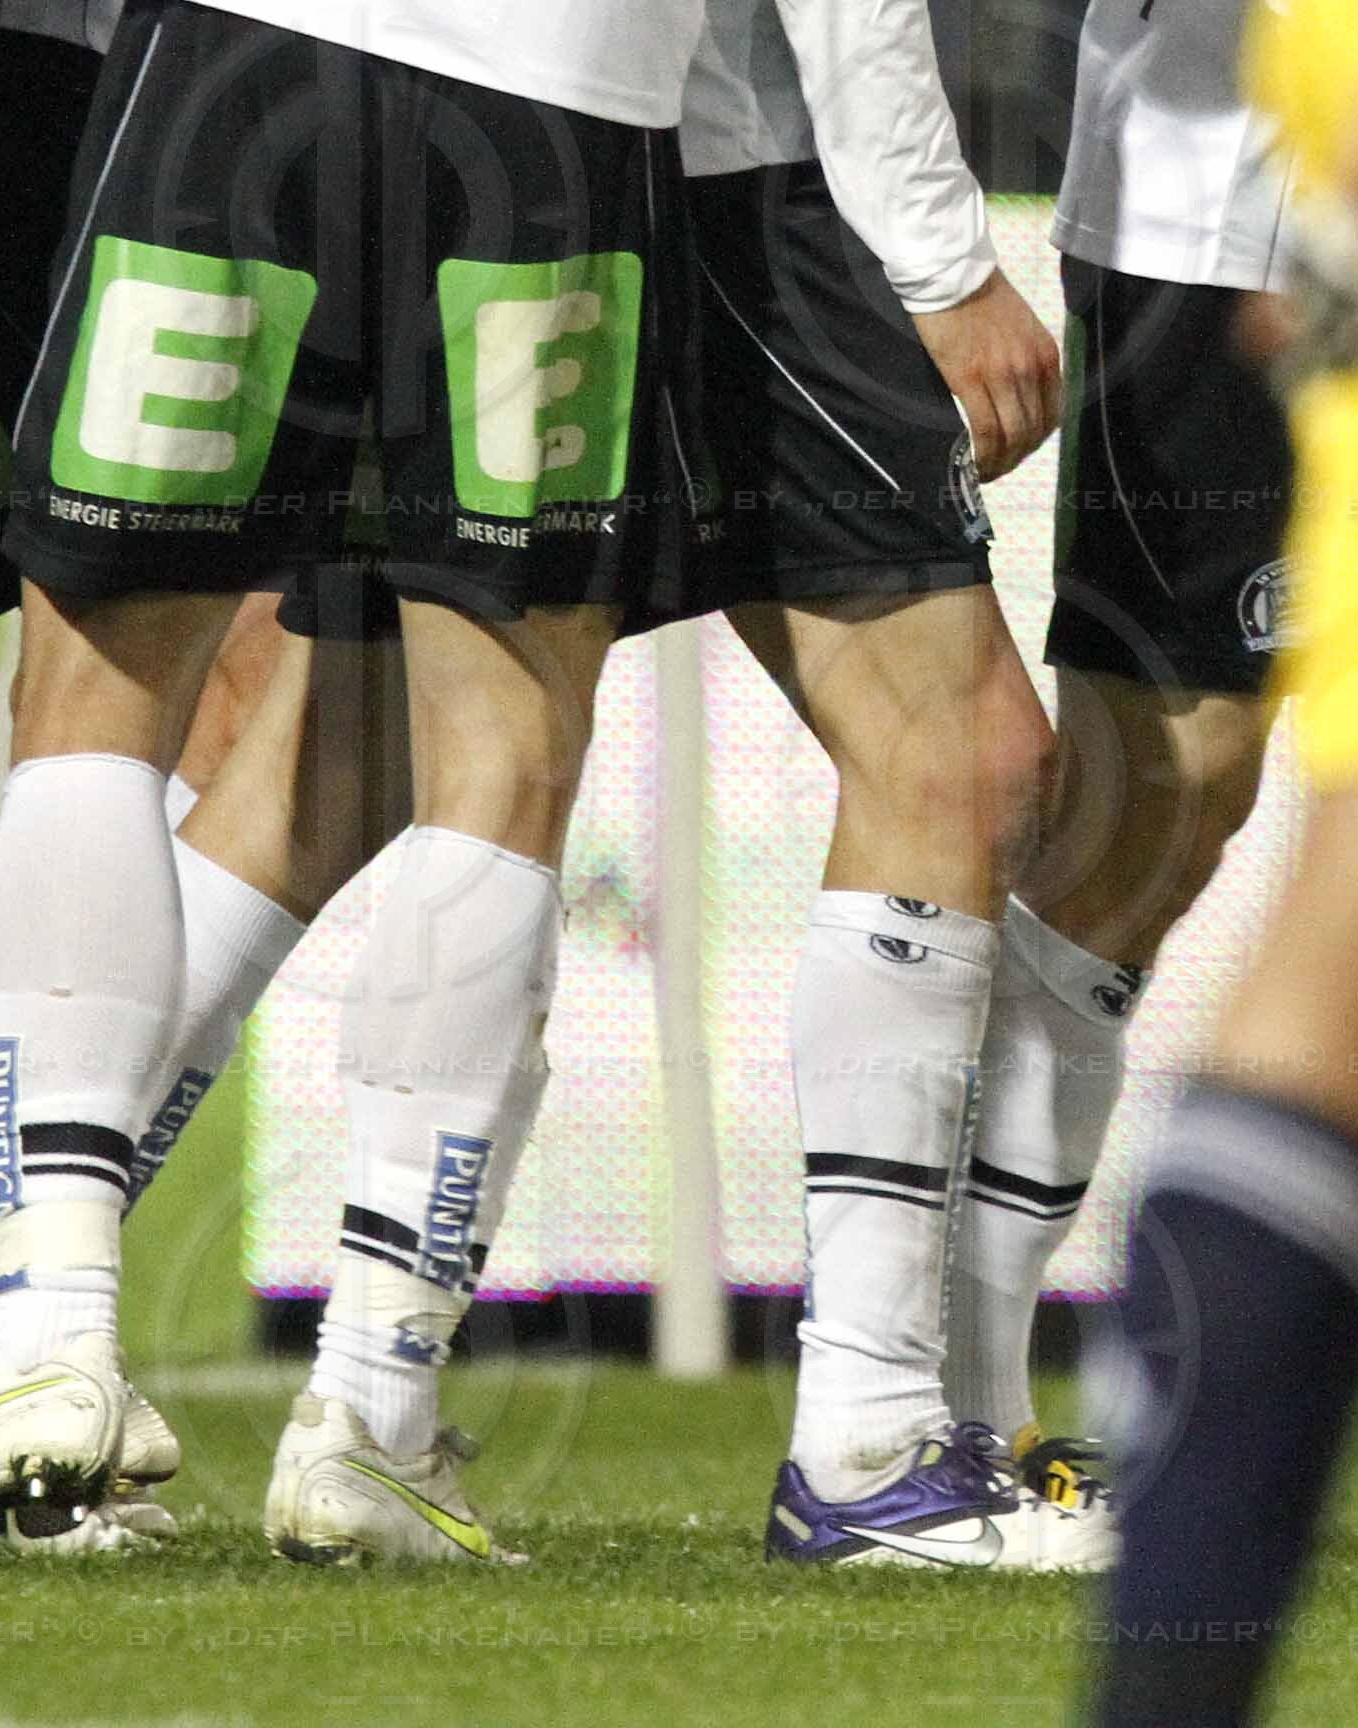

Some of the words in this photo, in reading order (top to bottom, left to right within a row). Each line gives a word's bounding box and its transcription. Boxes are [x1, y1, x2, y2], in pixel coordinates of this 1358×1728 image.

[78, 276, 260, 474] E
[49, 494, 122, 532] ENERGIE
[455, 518, 532, 550] ENERGIE
